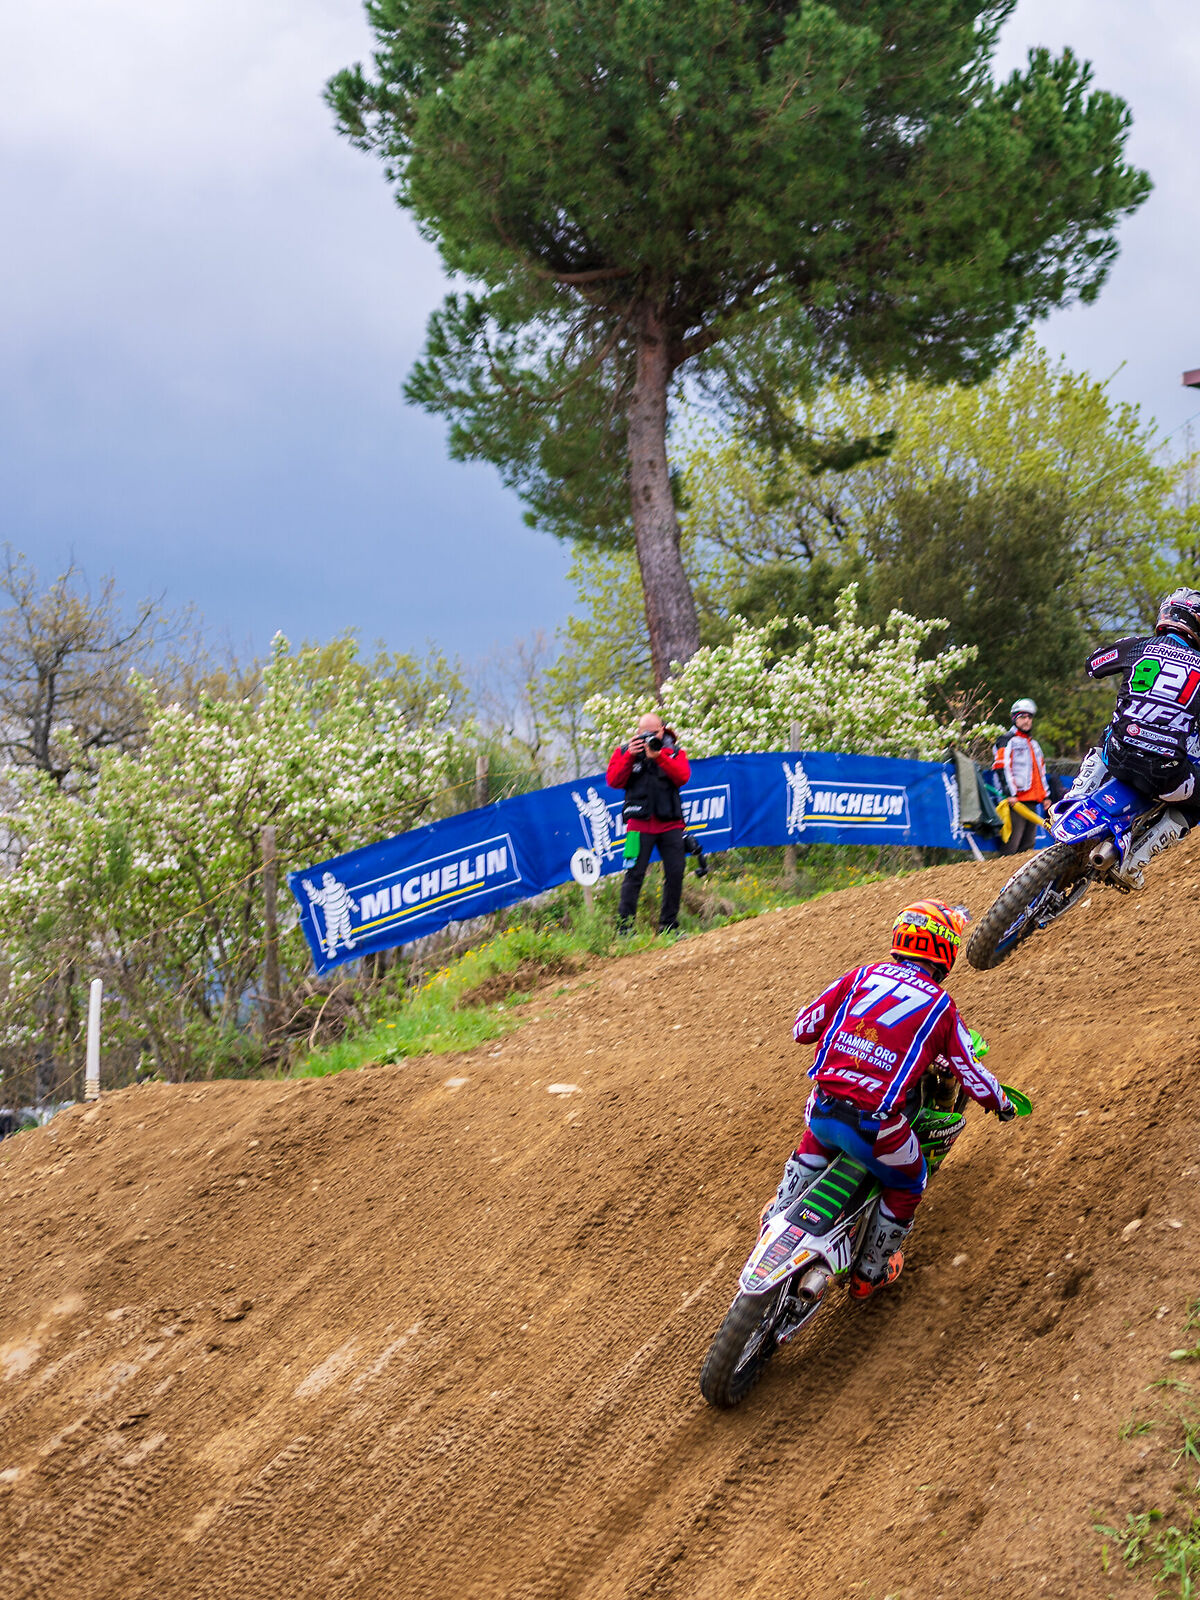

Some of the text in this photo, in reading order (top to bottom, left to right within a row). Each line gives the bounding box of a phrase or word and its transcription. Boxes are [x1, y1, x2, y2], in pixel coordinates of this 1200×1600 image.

[812, 791, 904, 815] MICHELIN
[578, 857, 594, 875] 16
[360, 846, 507, 922] MICHELIN
[849, 973, 934, 1028] 77
[834, 1042, 892, 1072] POLIZIA DI STATO
[837, 1031, 898, 1063] FIAMME ORO
